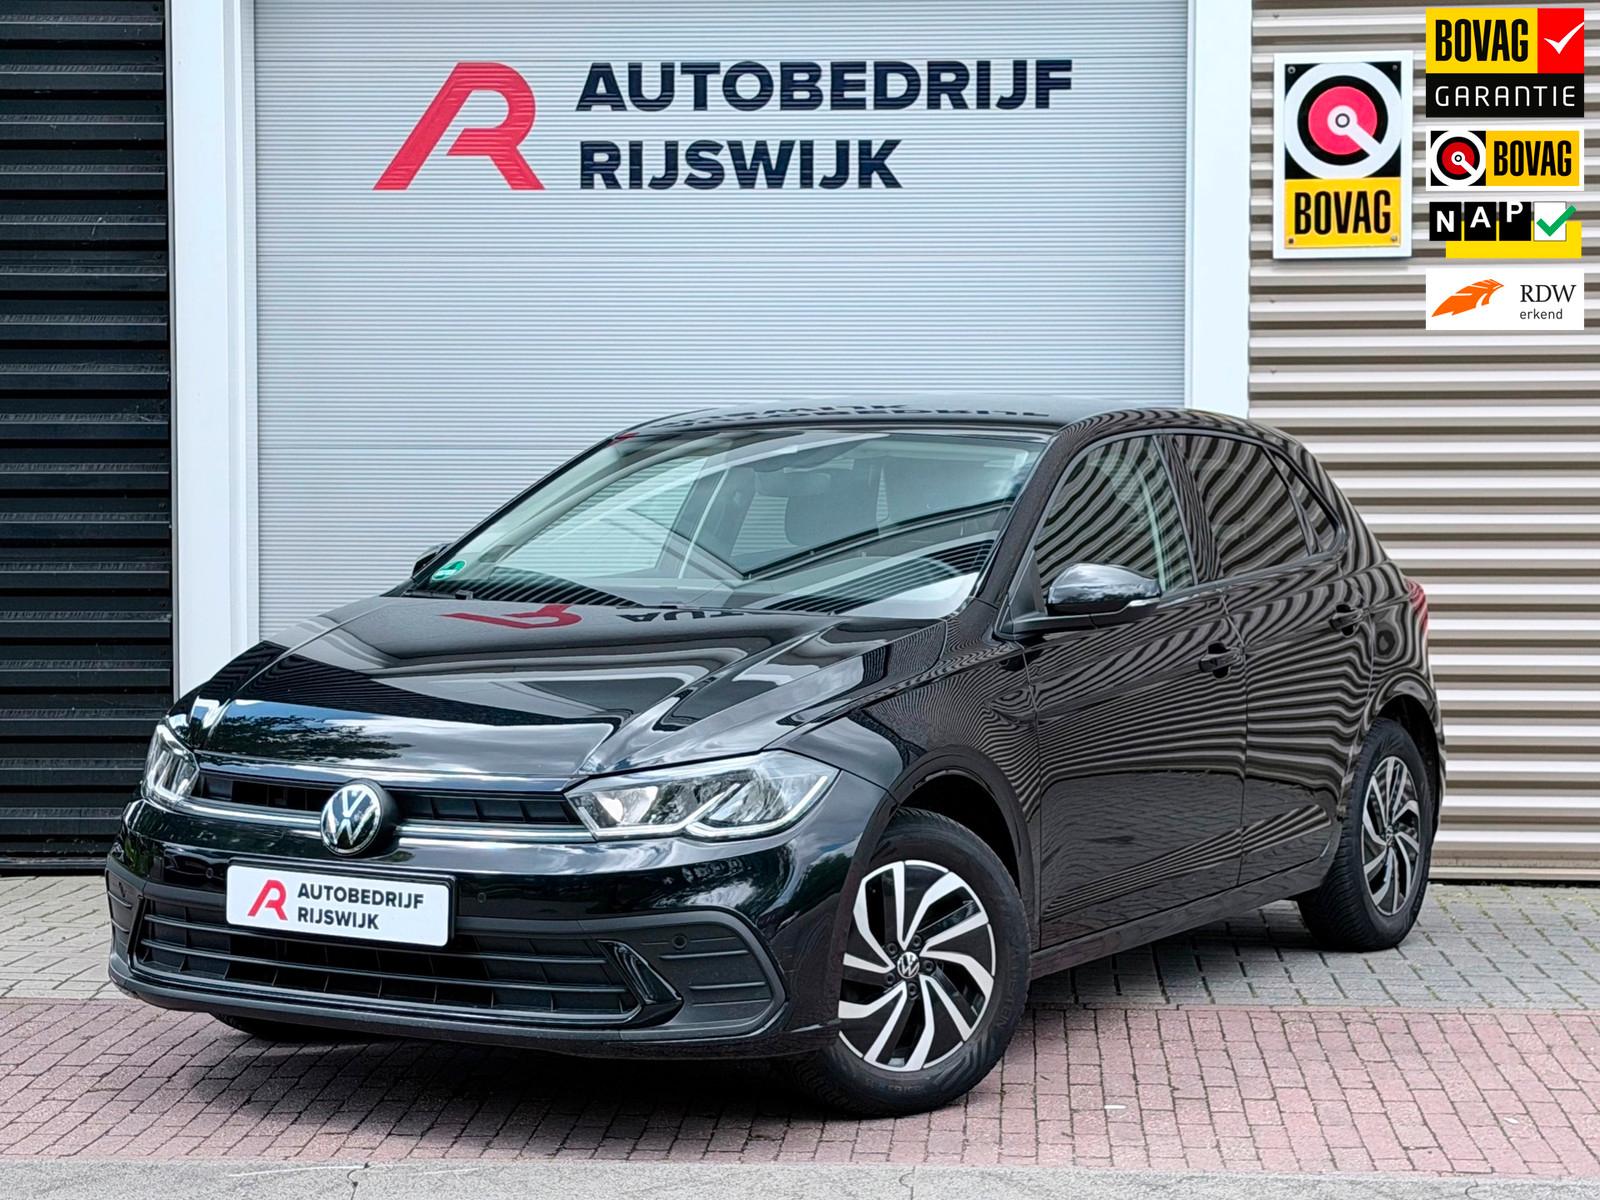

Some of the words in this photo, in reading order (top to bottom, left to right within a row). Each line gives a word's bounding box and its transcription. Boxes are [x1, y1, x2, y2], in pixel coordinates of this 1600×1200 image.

[575, 60, 1072, 111] AUTOBEDRIJF
[580, 140, 902, 189] RIJSWIJK
[1294, 190, 1391, 235] BOVAG
[297, 882, 424, 909] AUTOBEDRIJF
[297, 907, 380, 930] RIJSWIJK
